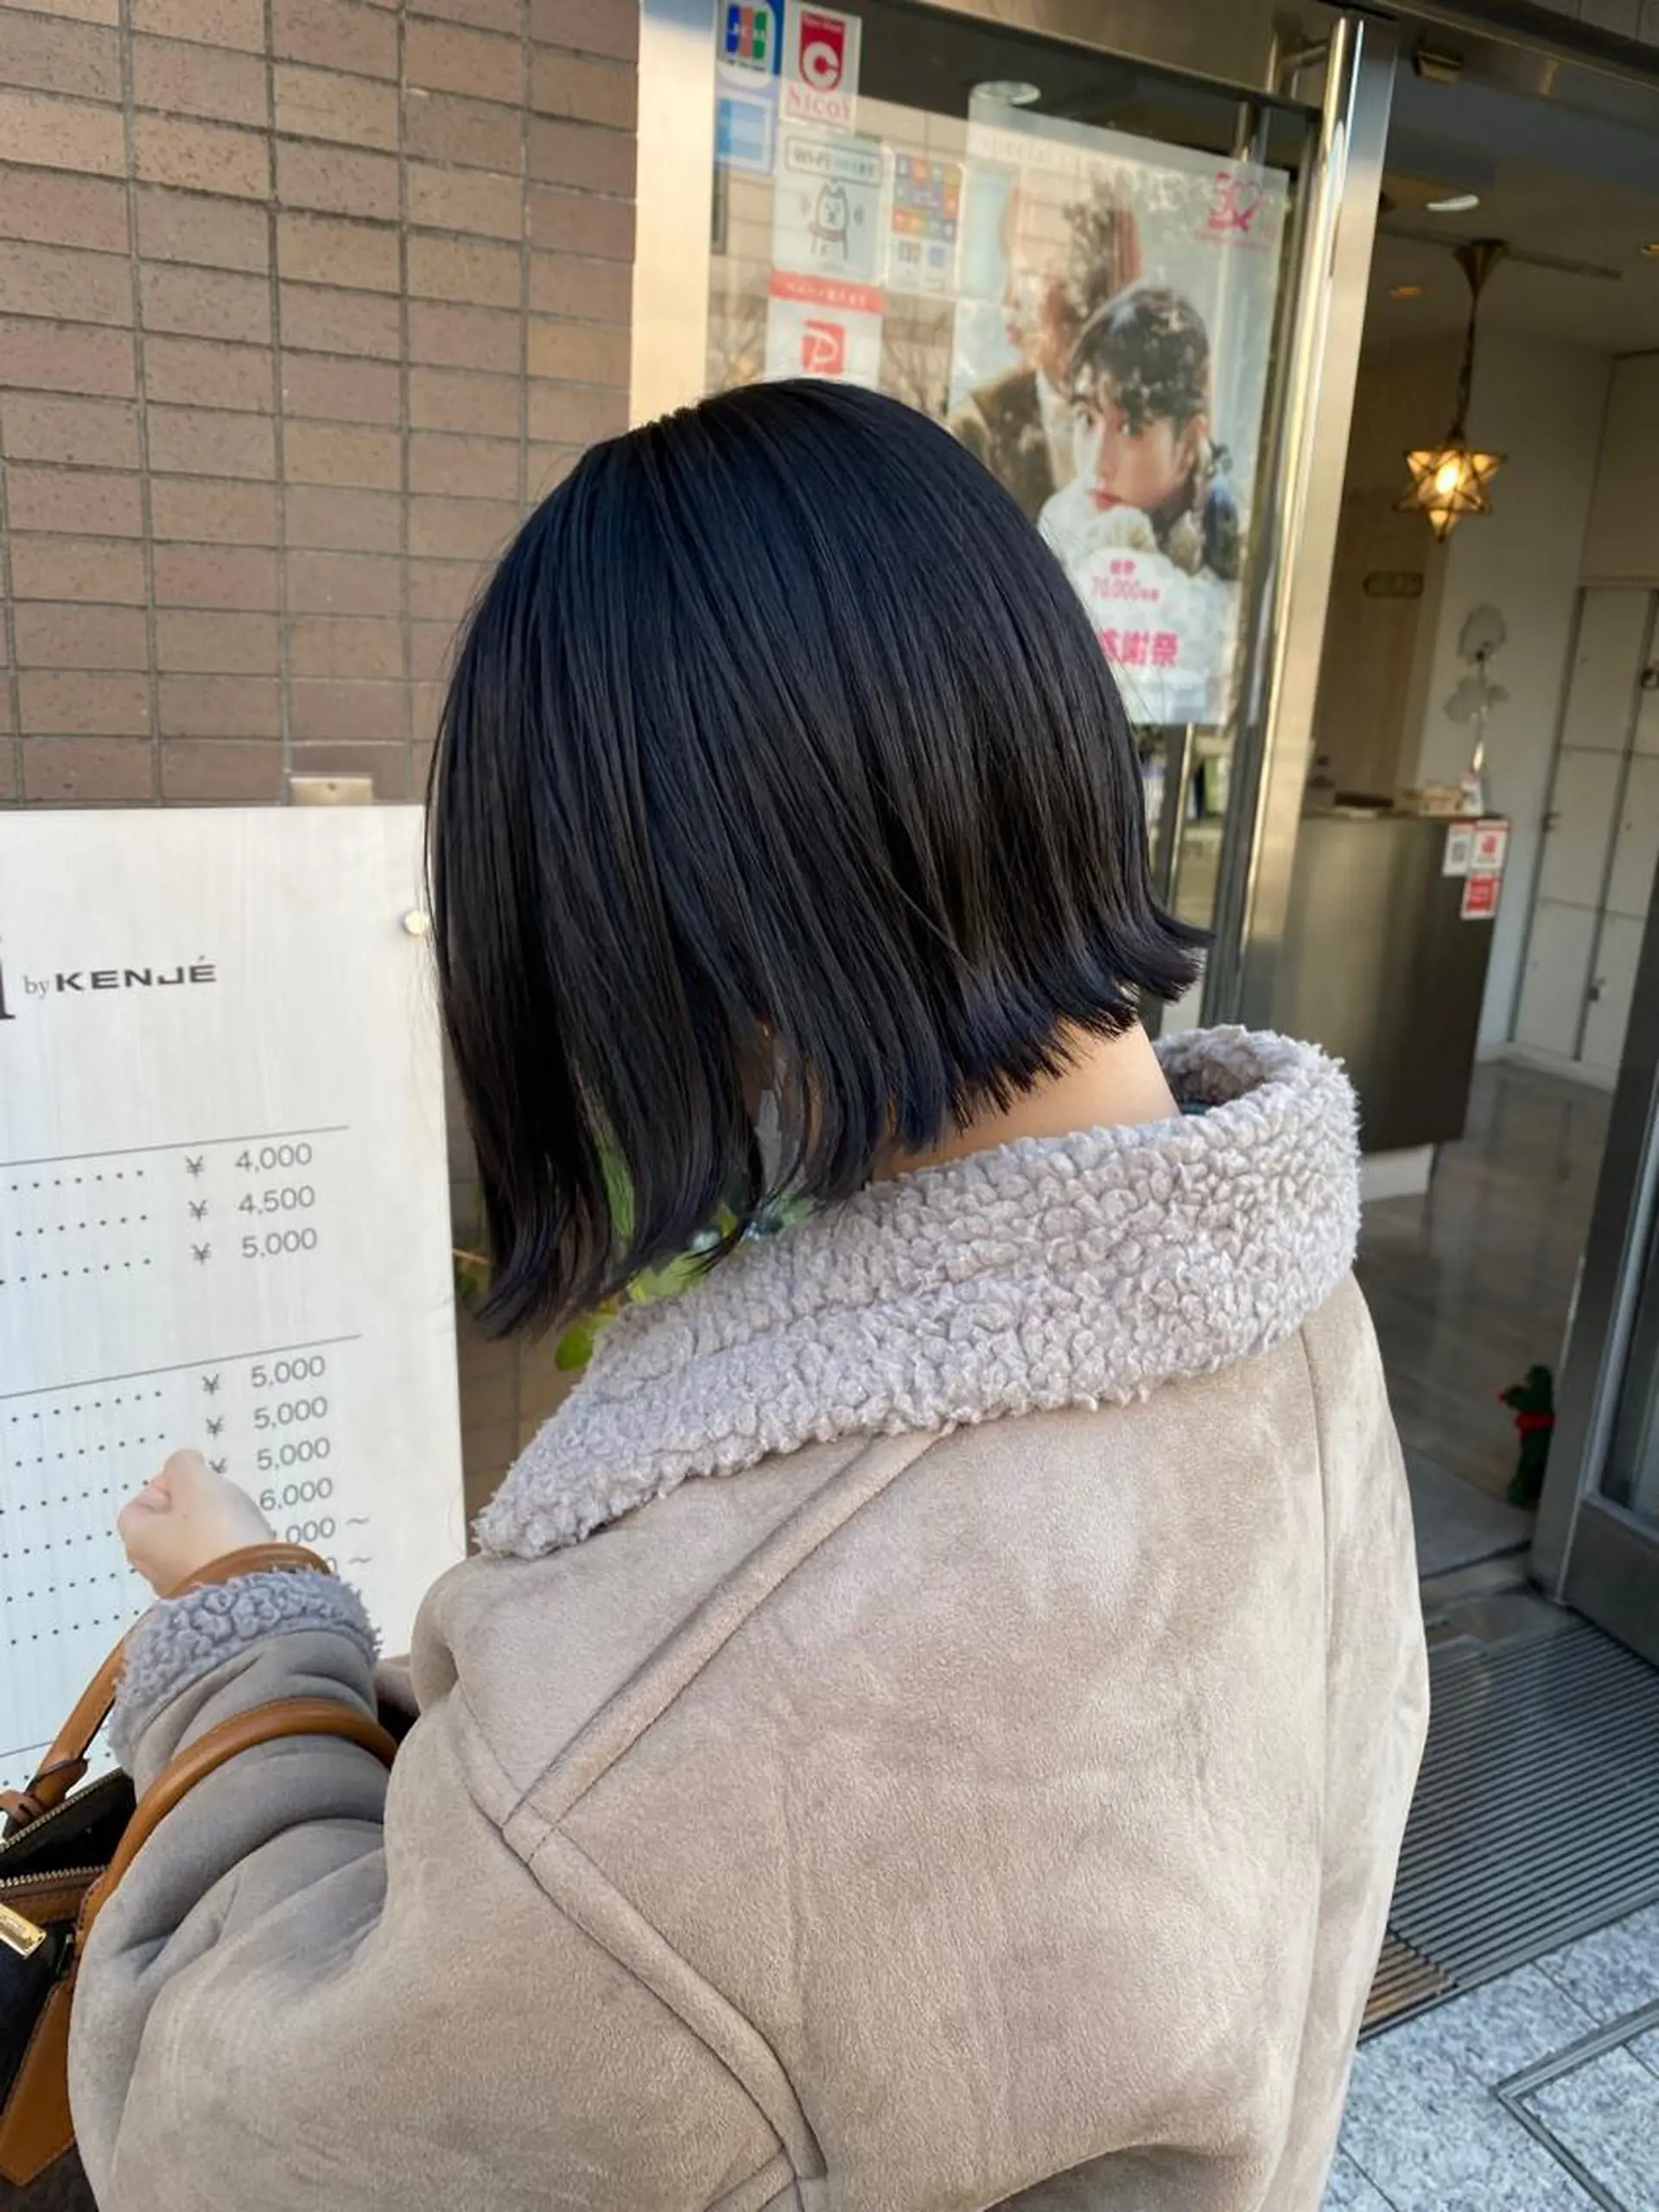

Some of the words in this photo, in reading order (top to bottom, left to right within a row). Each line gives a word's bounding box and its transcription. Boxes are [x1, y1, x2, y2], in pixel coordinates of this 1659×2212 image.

[23, 974, 50, 1000] by
[235, 1142, 312, 1173] 4,000
[238, 1185, 315, 1215] 4,500
[242, 1227, 318, 1259] 5,000
[251, 1355, 326, 1388] 5,000
[253, 1395, 328, 1429] 5,000
[256, 1436, 330, 1471] 5,000
[259, 1477, 333, 1511] 6,000
